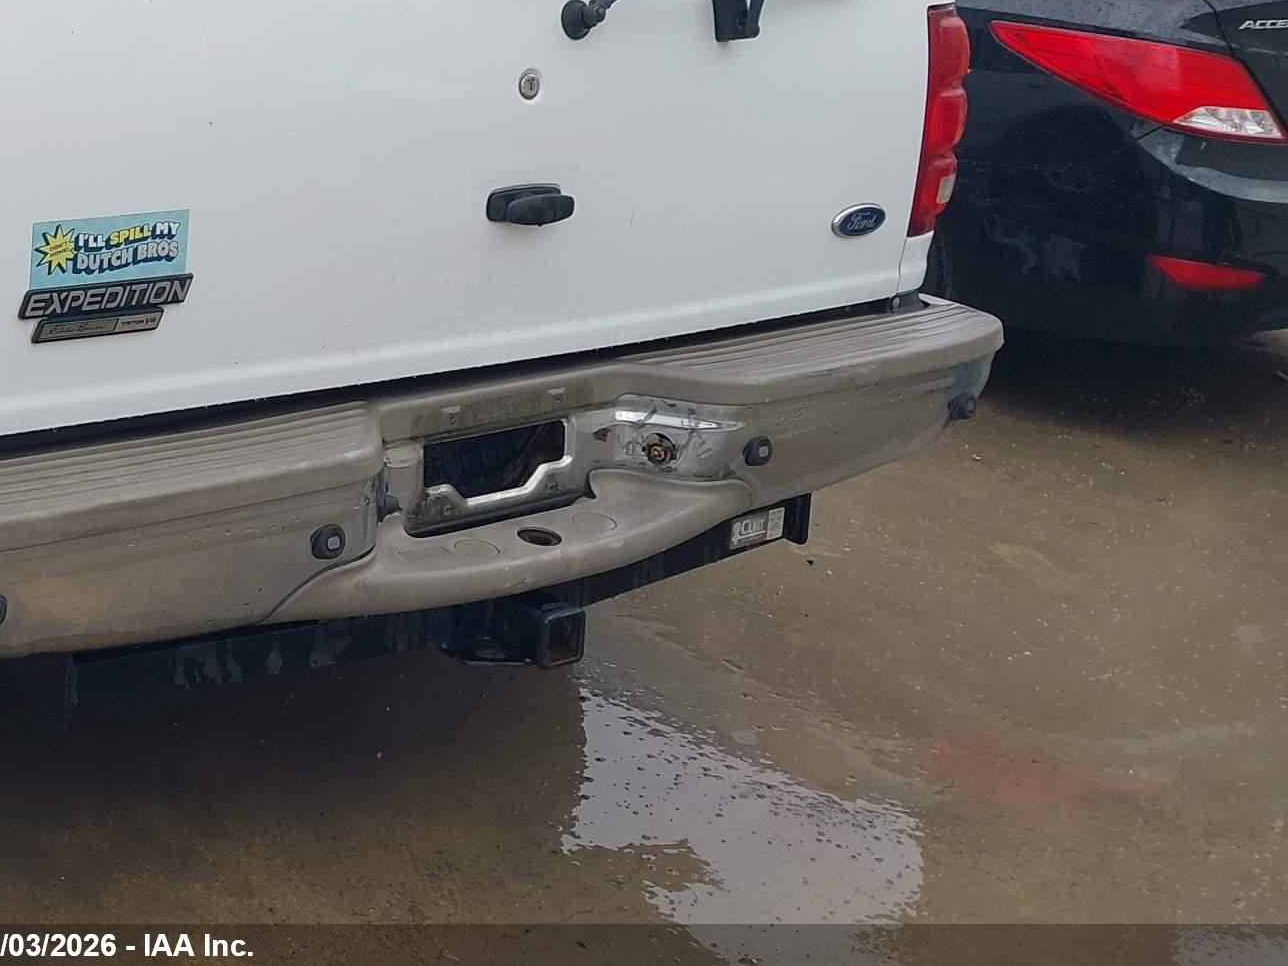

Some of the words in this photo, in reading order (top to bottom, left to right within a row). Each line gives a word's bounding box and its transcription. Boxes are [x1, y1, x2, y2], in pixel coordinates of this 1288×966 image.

[76, 232, 108, 249] I'LL
[109, 223, 153, 245] SPILL
[154, 220, 182, 236] MY
[847, 211, 878, 230] Ford
[75, 248, 134, 272] DUTCH
[136, 240, 179, 259] BROS
[24, 280, 192, 317] EXPEDITION
